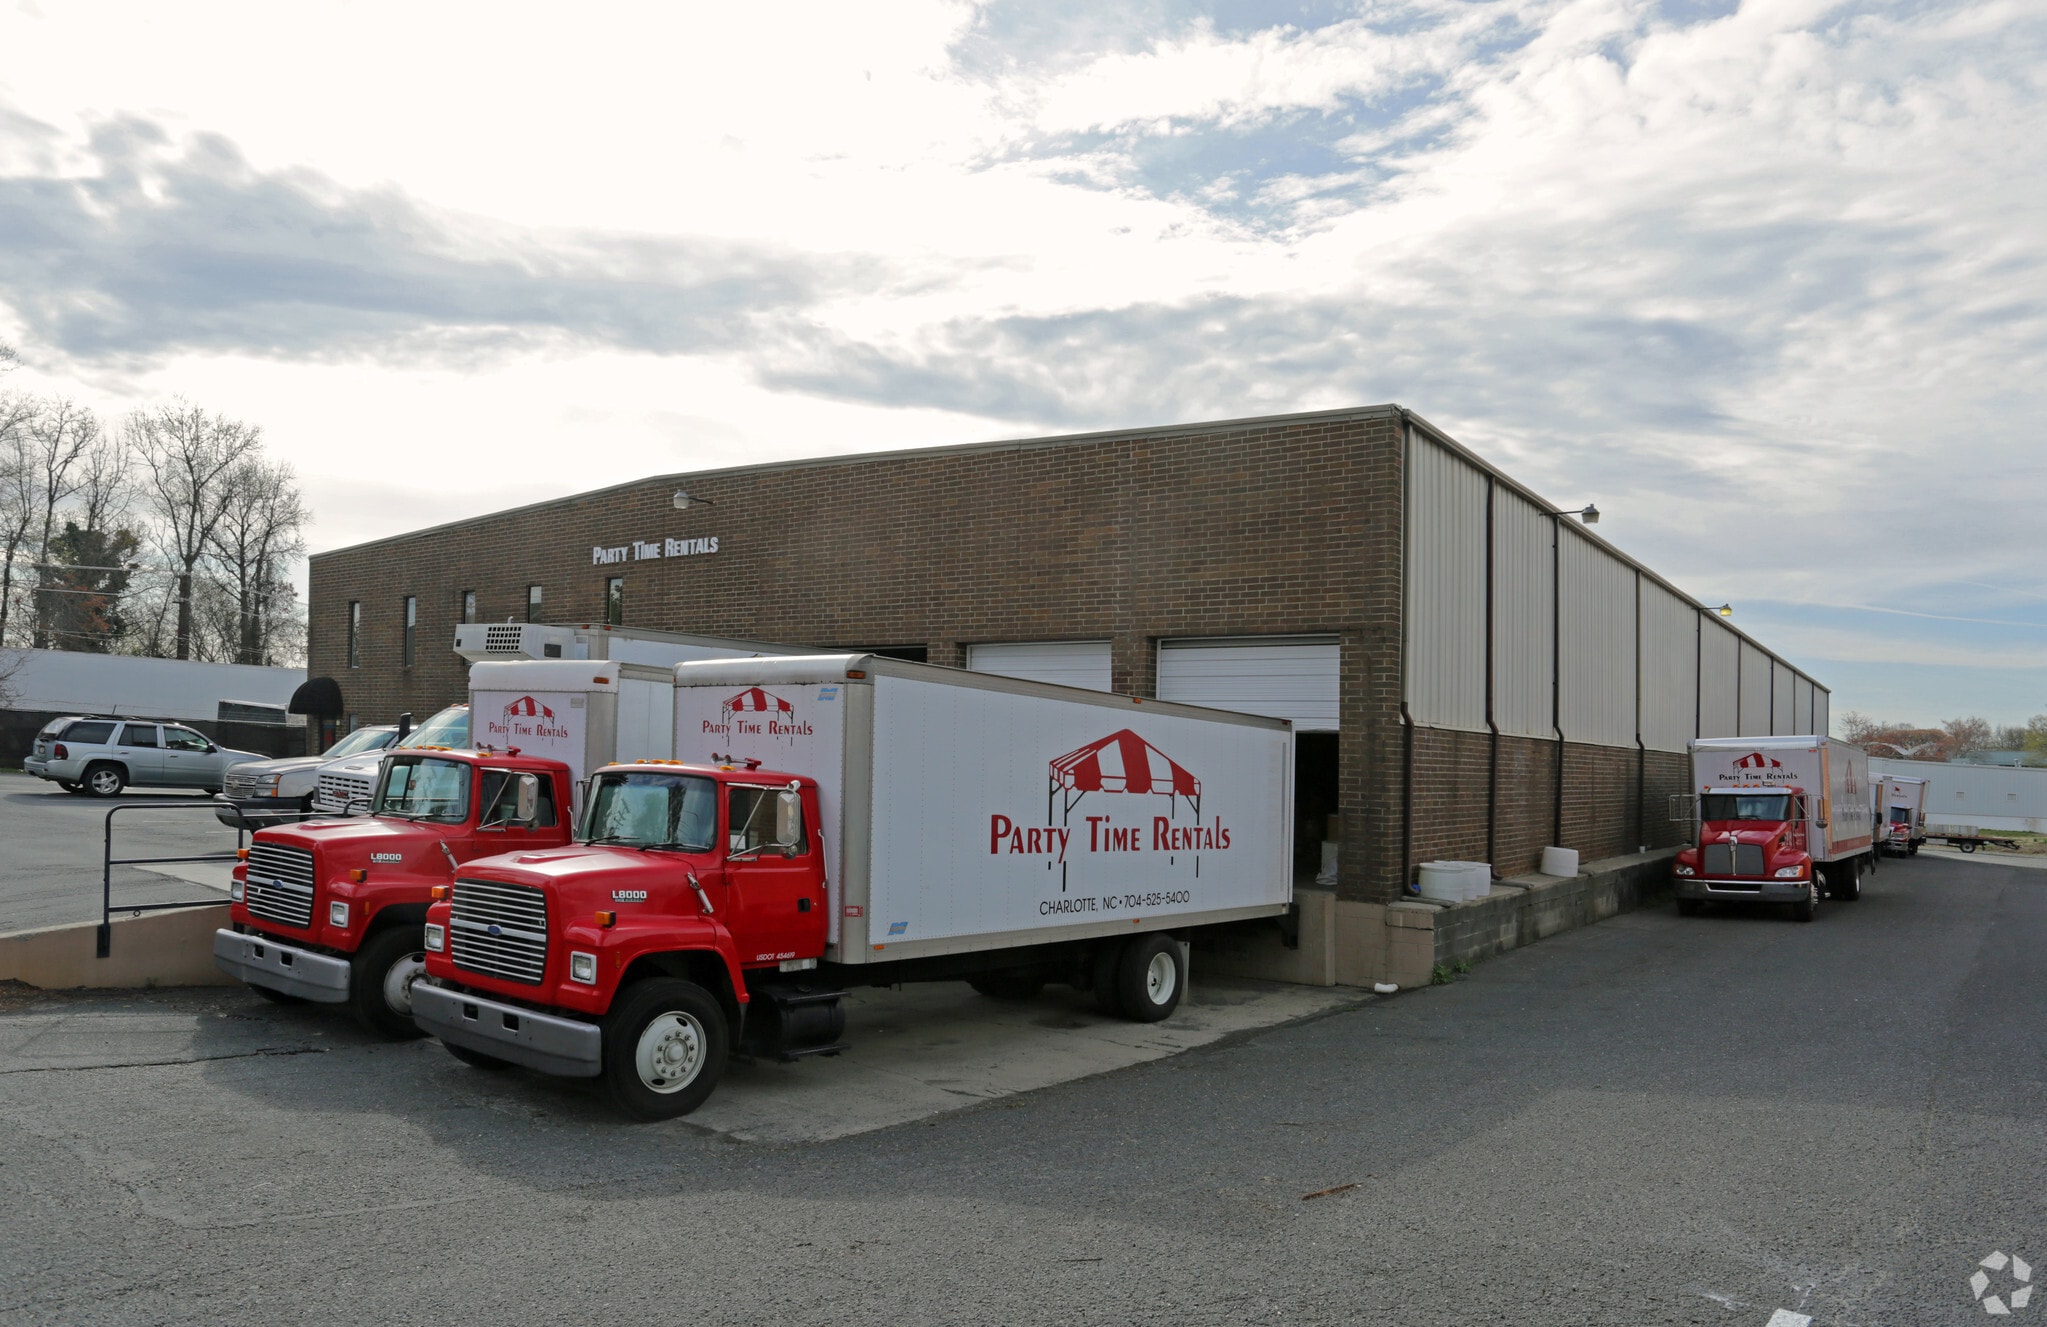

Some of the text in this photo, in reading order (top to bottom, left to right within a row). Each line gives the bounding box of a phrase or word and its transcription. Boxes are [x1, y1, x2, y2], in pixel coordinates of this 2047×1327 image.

[593, 537, 719, 565] PARTY TIME RENTALS
[612, 890, 647, 899] L8000
[1039, 897, 1099, 915] CHARLOTTE,
